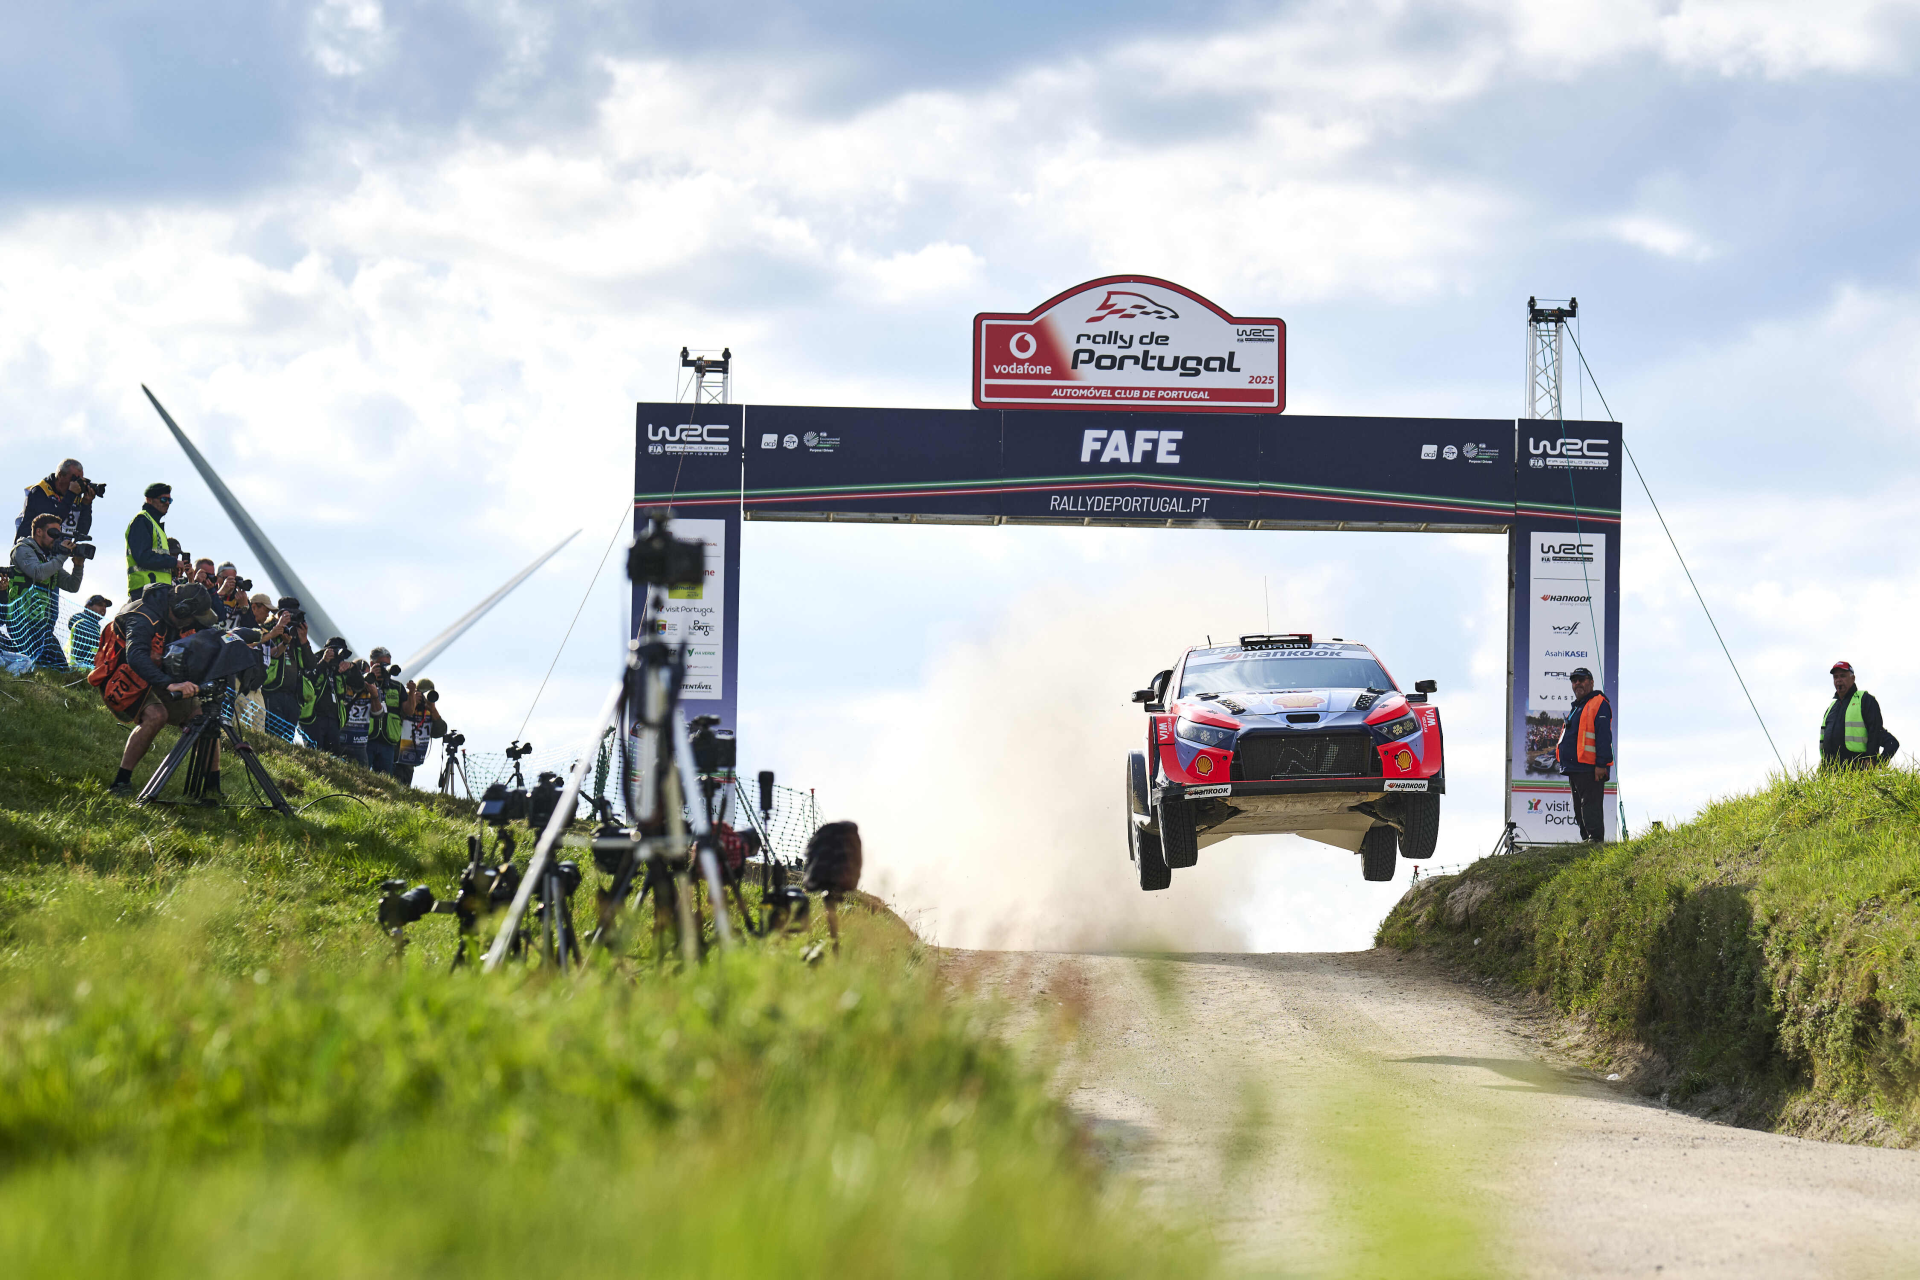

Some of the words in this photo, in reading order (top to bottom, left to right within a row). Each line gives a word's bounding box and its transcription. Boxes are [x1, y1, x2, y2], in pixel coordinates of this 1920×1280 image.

[1237, 328, 1275, 337] WRC
[1076, 330, 1134, 349] rally
[1138, 331, 1170, 346] de
[993, 362, 1052, 375] vodafone
[1071, 349, 1241, 377] Portugal
[1248, 375, 1275, 385] 2025
[1051, 387, 1113, 398] AUTOMÓVEL
[1115, 389, 1140, 399] CLUB
[1142, 390, 1157, 399] DE
[1158, 390, 1210, 400] PORTUGAL
[648, 423, 730, 442] WRC
[1080, 429, 1184, 464] FAFE
[1529, 437, 1609, 457] WRC
[1049, 495, 1211, 513] RALLYDEPORTUGAL.PT
[1541, 543, 1594, 555] WRC
[665, 605, 680, 613] visit
[680, 606, 715, 617] Portugal
[1242, 650, 1342, 659] Hankook
[351, 706, 369, 718] 27
[1545, 800, 1571, 812] visit
